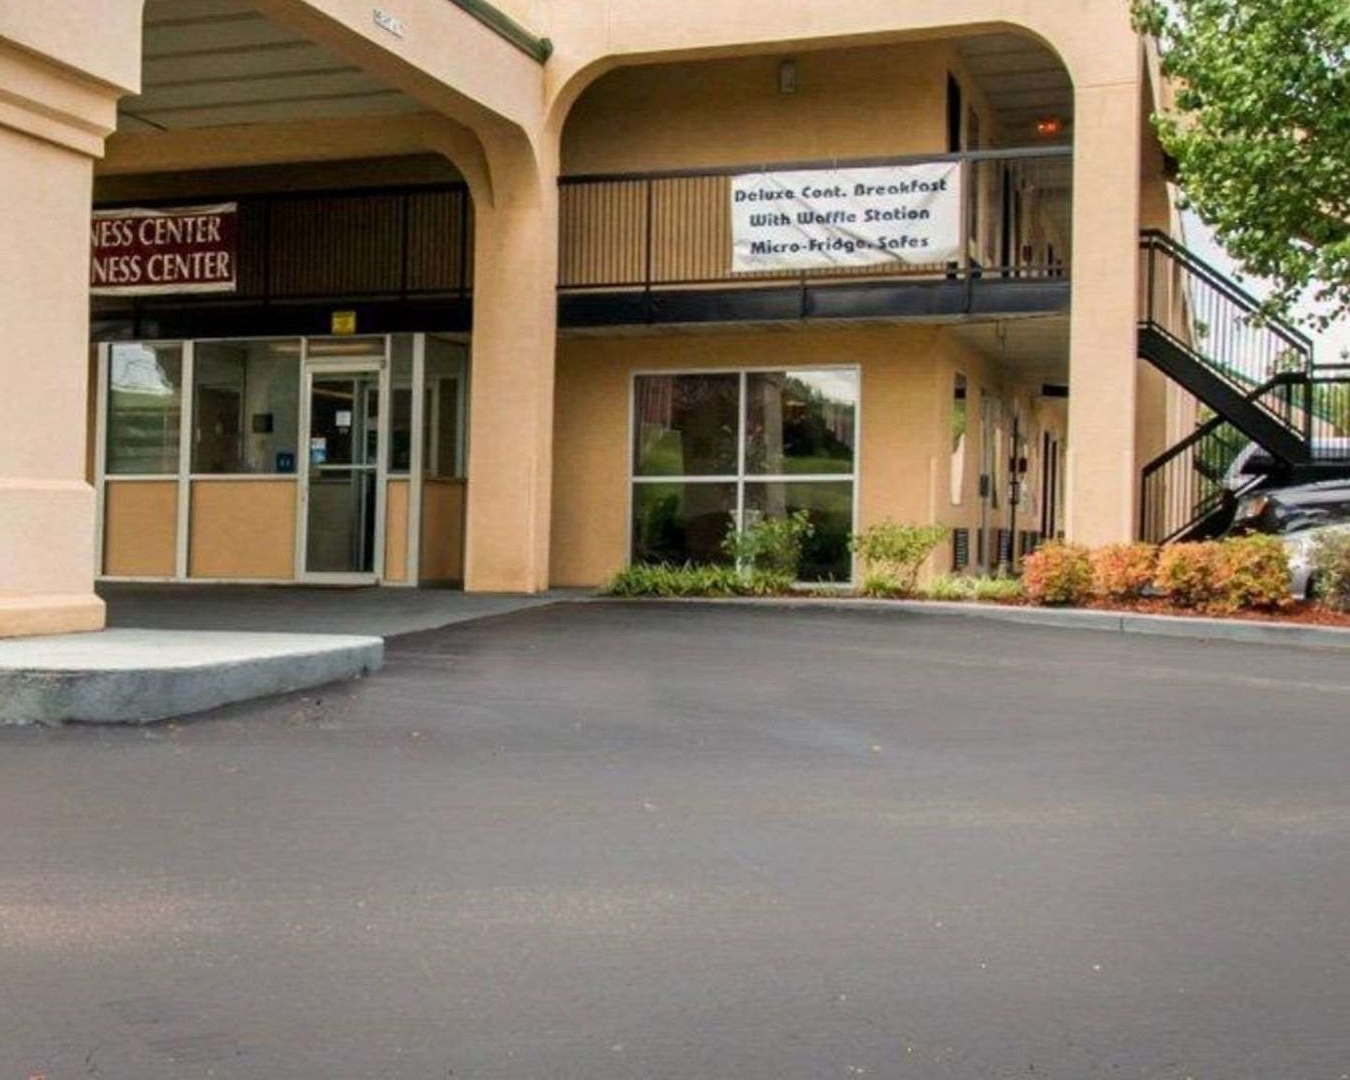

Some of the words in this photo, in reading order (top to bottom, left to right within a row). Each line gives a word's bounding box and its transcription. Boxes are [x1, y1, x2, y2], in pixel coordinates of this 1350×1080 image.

[735, 189, 796, 202] Deluxe
[801, 185, 847, 199] Cont.
[853, 178, 947, 197] Breakfast
[750, 214, 791, 227] With
[797, 211, 856, 225] Waffle
[864, 207, 930, 222] Station
[138, 217, 221, 245] CENTER
[878, 234, 929, 250] Safes
[147, 251, 229, 281] CENTER
